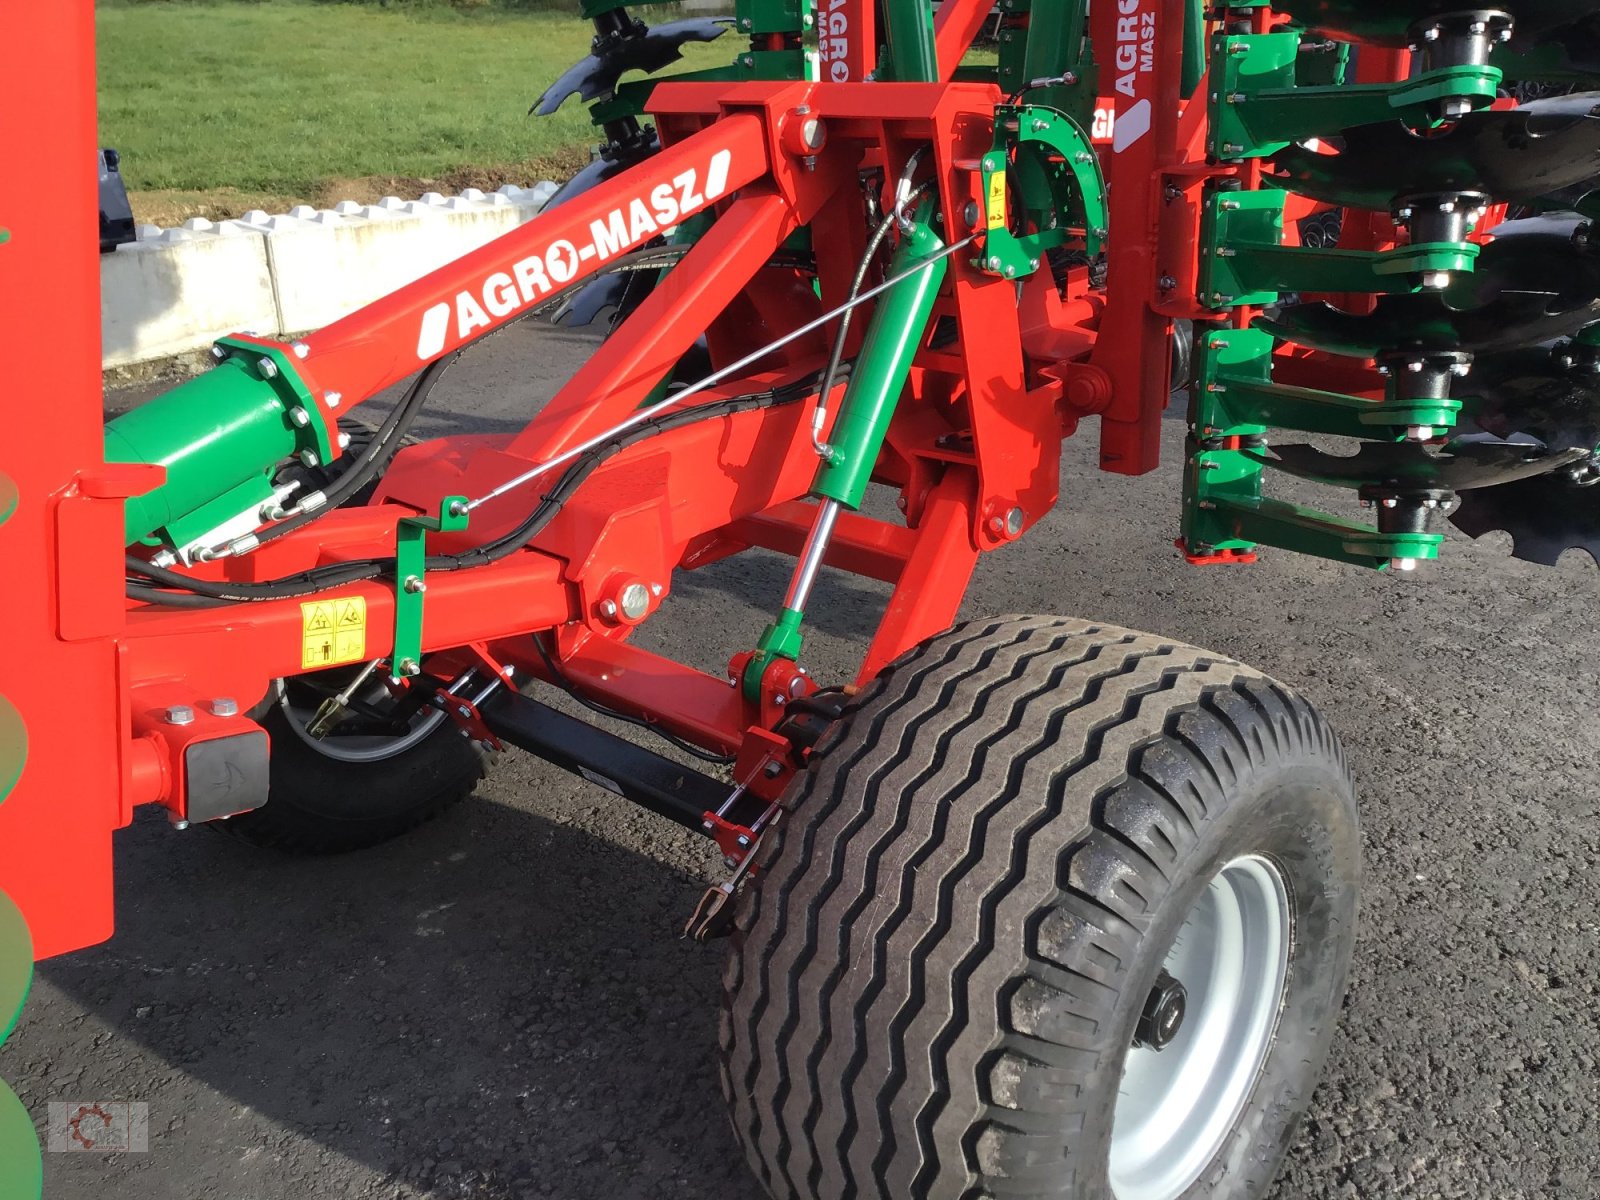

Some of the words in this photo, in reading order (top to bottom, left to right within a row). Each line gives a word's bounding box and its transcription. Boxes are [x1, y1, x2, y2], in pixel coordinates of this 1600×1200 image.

[818, 11, 829, 62] MASZ
[1140, 12, 1155, 72] MASZ
[457, 168, 704, 339] AGRO-MASZ
